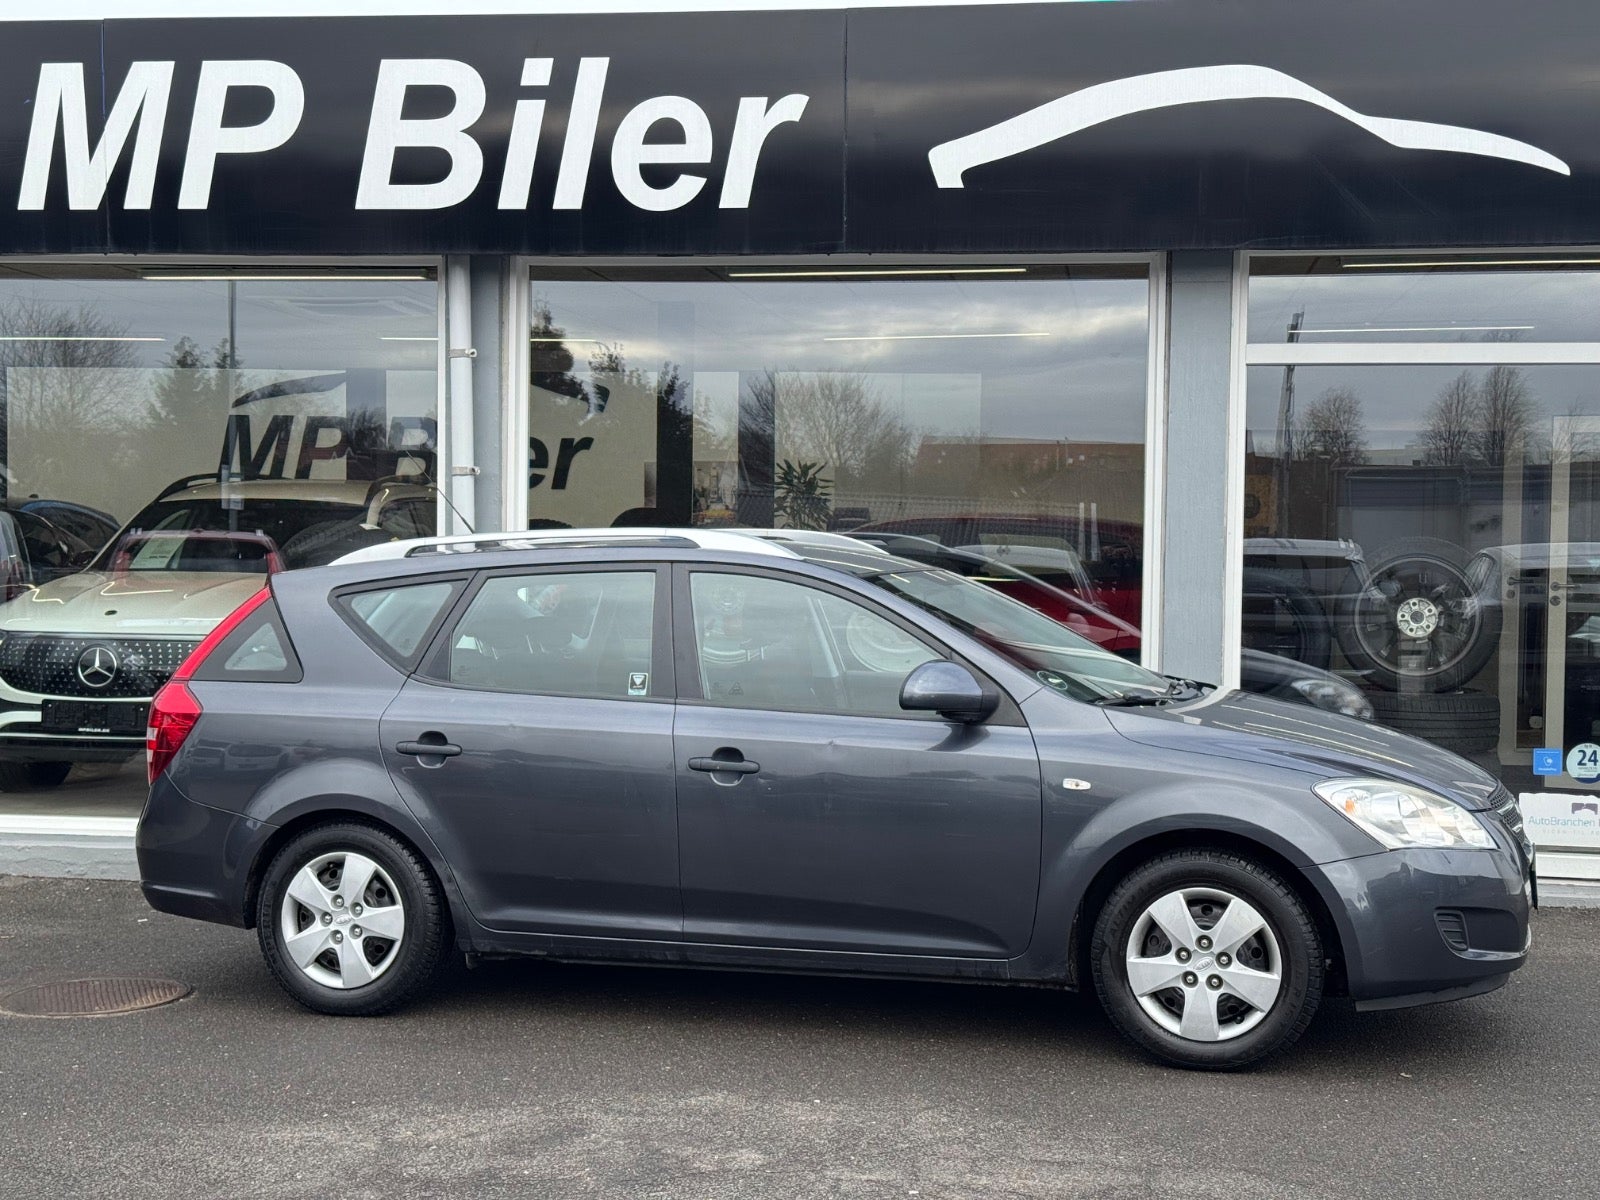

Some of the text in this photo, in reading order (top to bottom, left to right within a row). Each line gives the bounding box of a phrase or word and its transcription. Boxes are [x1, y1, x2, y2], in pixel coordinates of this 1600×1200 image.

[18, 56, 810, 212] MP Biler
[218, 414, 352, 480] MP
[1577, 749, 1599, 767] 24
[1528, 815, 1596, 828] AutoBranchen
